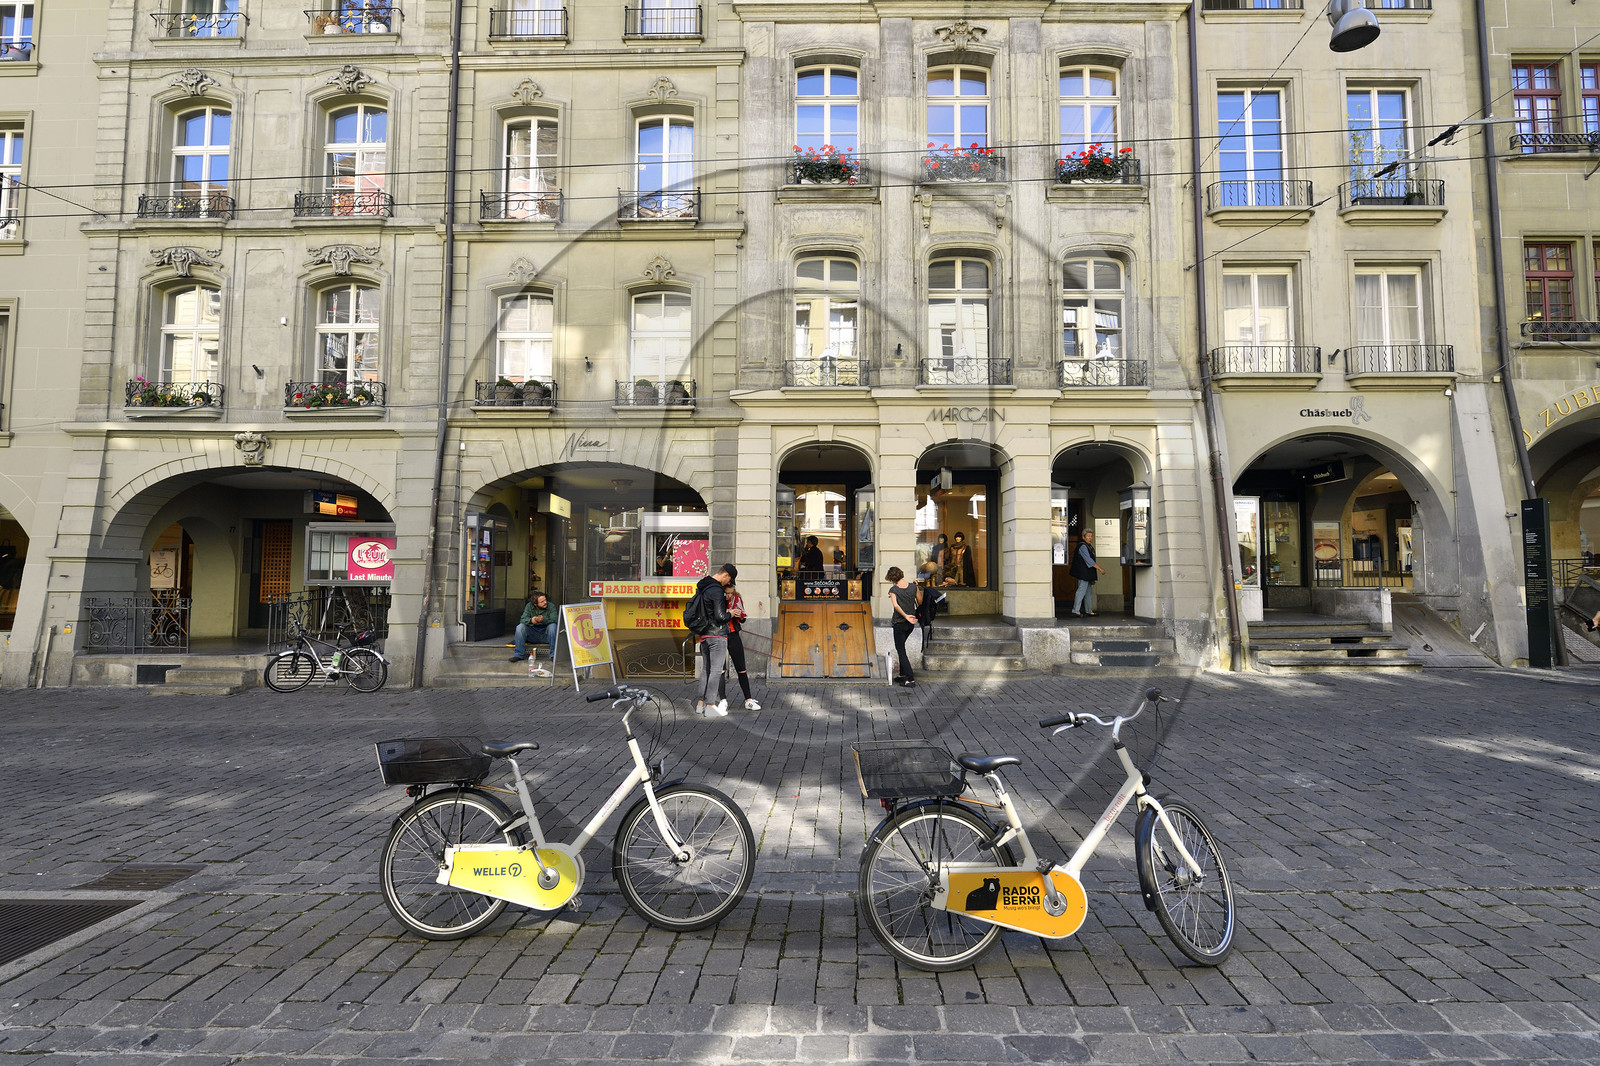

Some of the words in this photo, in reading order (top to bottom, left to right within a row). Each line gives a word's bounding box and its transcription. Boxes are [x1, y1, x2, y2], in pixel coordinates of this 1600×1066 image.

[1300, 409, 1352, 417] Chäsbueb
[559, 427, 608, 460] Nina
[350, 573, 366, 581] Last
[367, 573, 393, 581] Minute
[605, 585, 640, 594] BADER
[643, 585, 693, 594] COIFFEUR
[638, 600, 679, 609] DAMEN
[636, 619, 680, 628] HERREN
[473, 867, 507, 876] WELLE
[1003, 886, 1040, 895] RADIO
